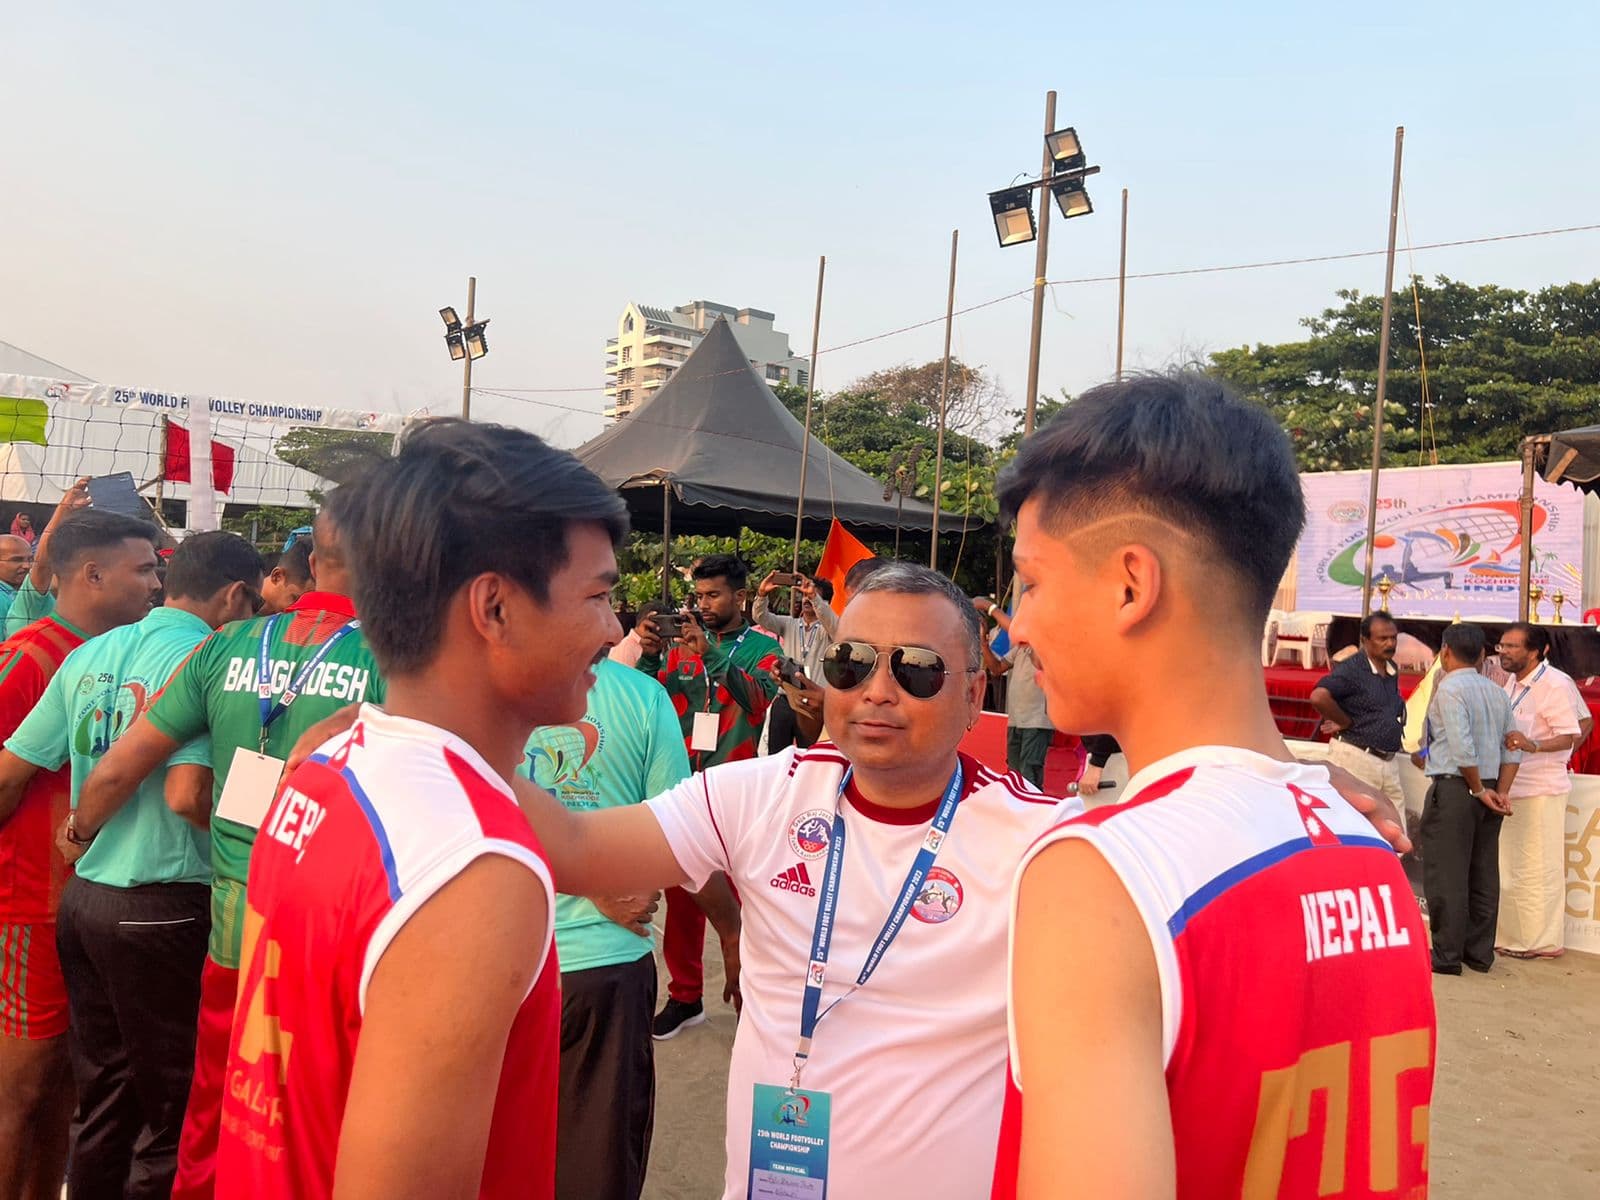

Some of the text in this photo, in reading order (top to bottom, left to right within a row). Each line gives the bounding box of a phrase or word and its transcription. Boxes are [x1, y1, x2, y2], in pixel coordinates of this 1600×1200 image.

[114, 390, 136, 404] 25th
[139, 391, 178, 409] WORLD
[208, 399, 246, 415] VOLLEY
[248, 403, 323, 422] CHAMPIONSHIP
[1376, 498, 1407, 510] 25th
[827, 851, 840, 892] CHAMPIONSHIP
[770, 878, 816, 897] adidas
[1300, 884, 1411, 963] NEPAL
[770, 1130, 790, 1141] WORLD
[769, 1140, 810, 1153] CHAMPIONSHIP
